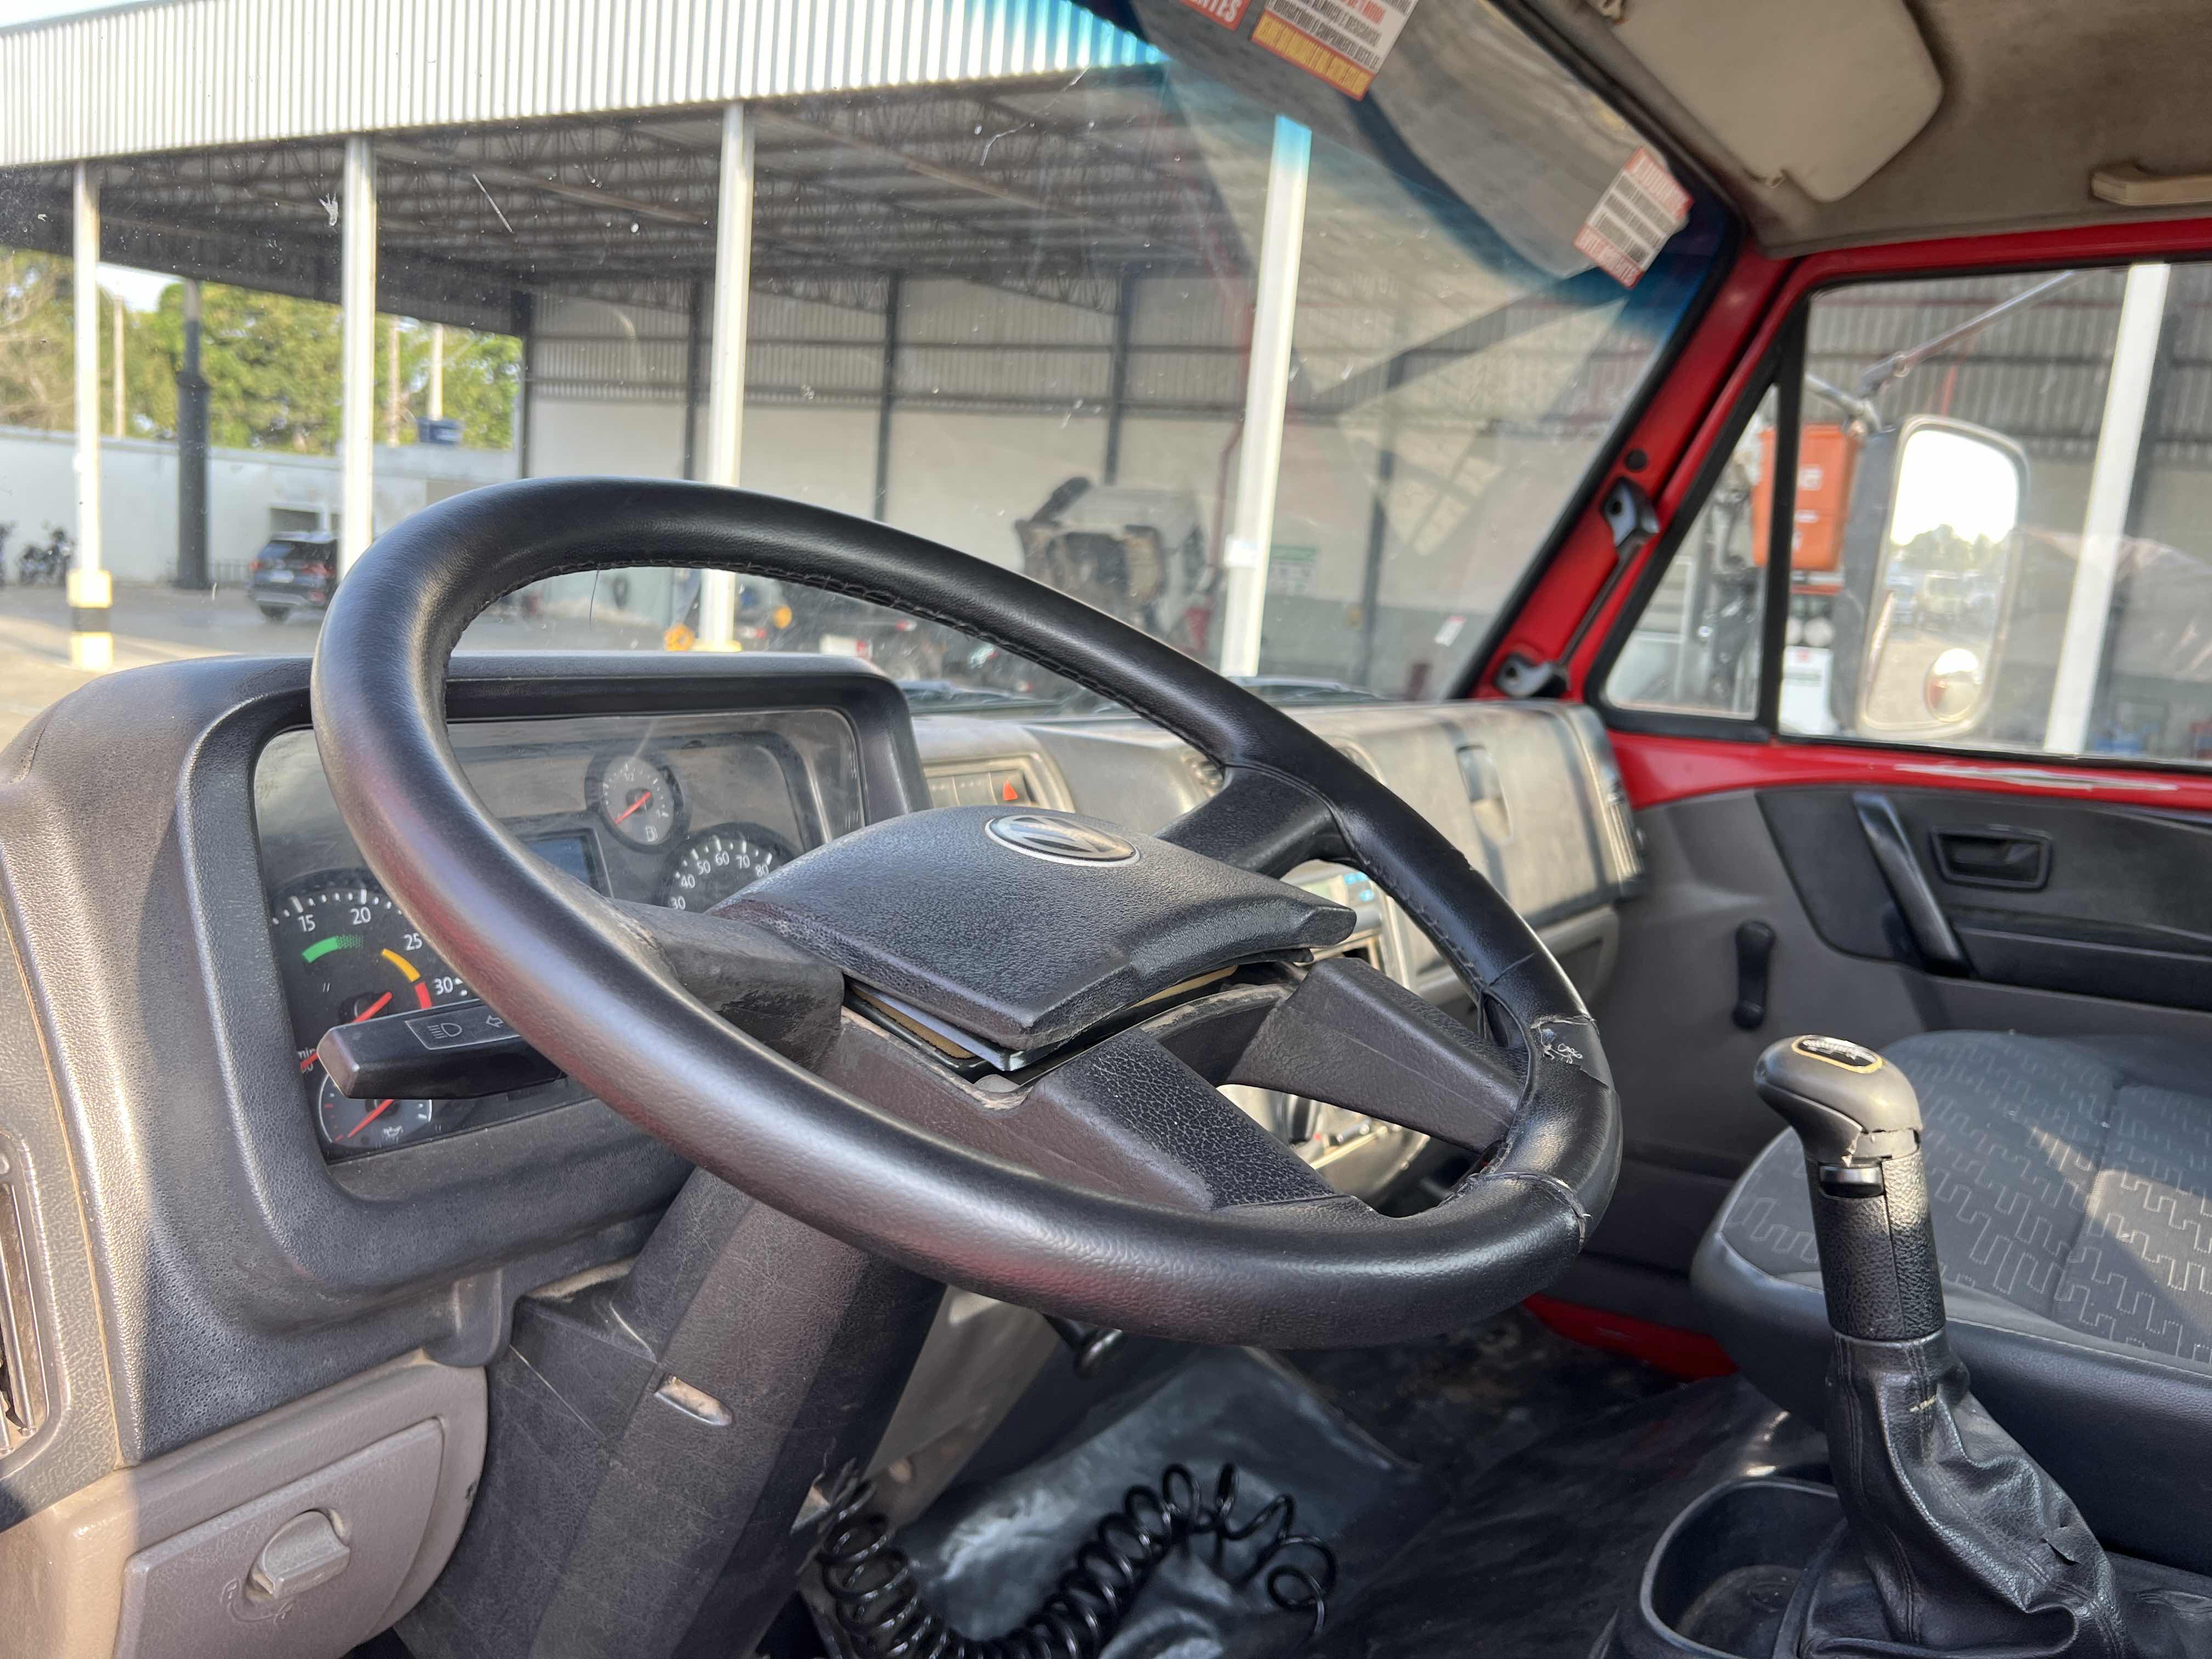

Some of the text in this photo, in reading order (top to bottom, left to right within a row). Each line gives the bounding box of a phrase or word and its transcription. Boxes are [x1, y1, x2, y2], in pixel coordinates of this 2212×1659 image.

[715, 851, 730, 866] 60
[736, 854, 751, 870] 70
[696, 860, 711, 875] 50
[755, 864, 769, 878] 80
[680, 873, 696, 889] 40
[670, 895, 686, 910] 30
[298, 913, 316, 932] 15
[350, 906, 371, 926] 20
[403, 932, 423, 951] 25
[433, 976, 454, 995] 30
